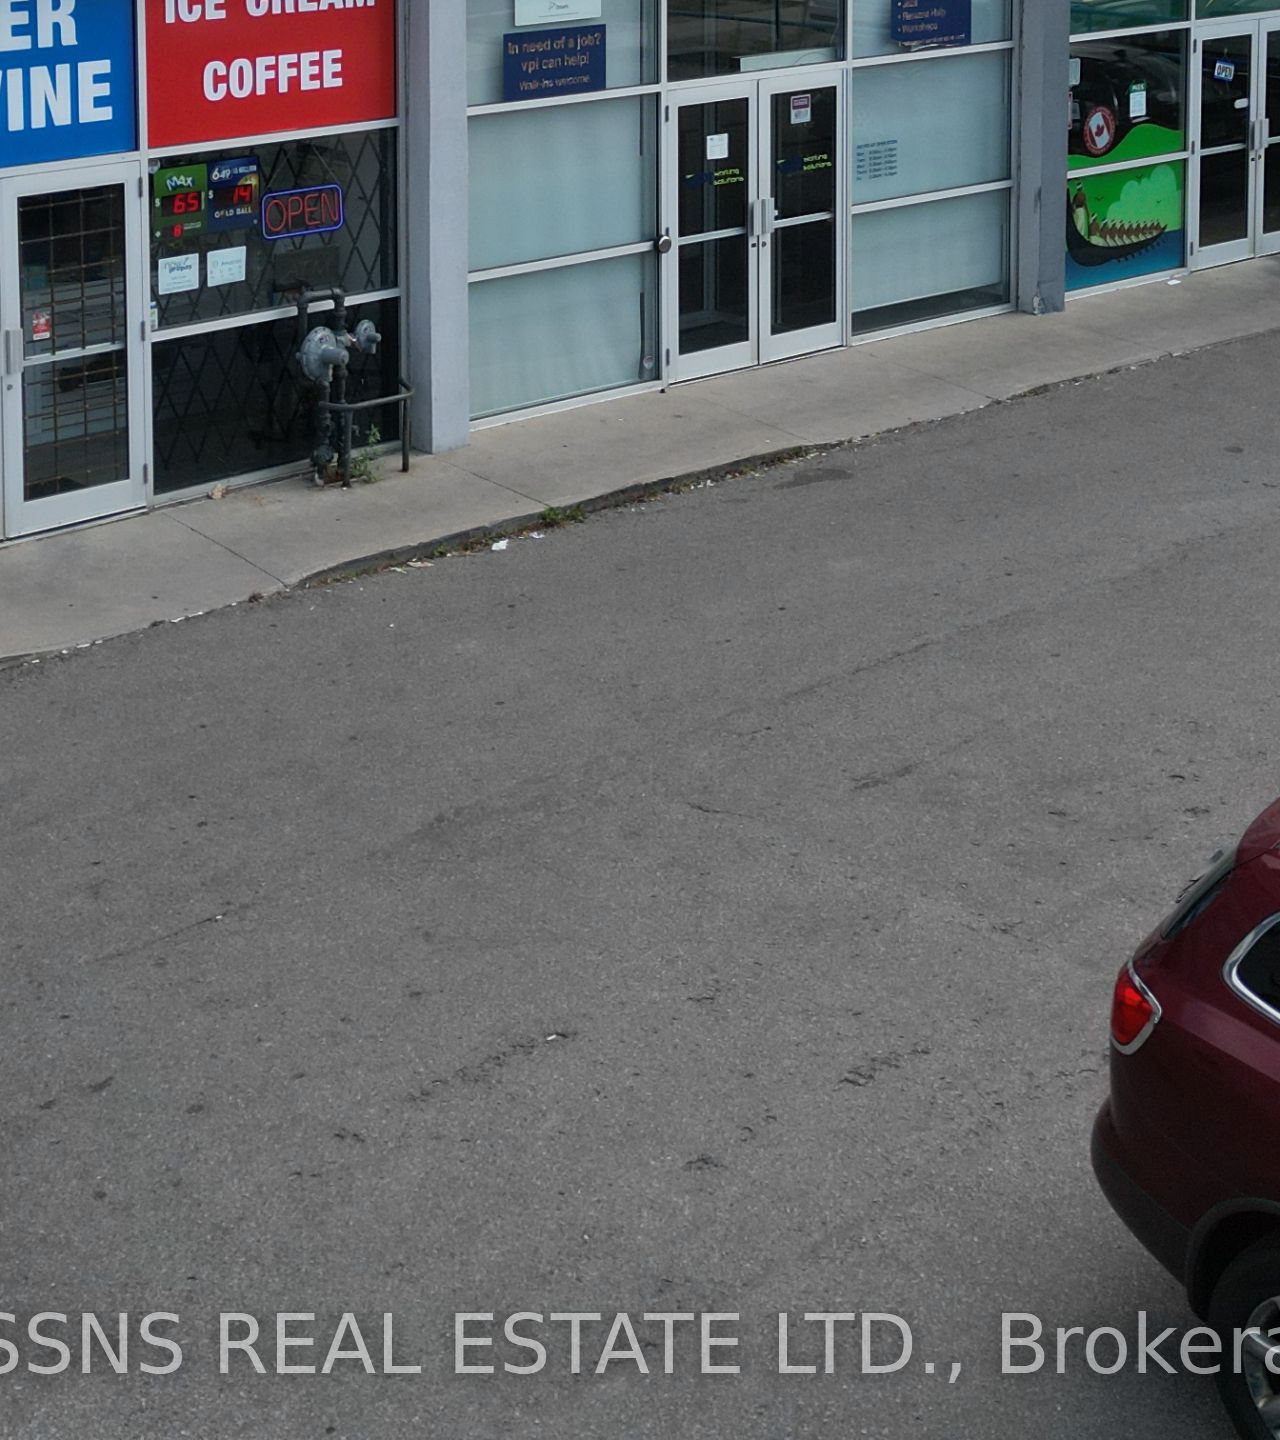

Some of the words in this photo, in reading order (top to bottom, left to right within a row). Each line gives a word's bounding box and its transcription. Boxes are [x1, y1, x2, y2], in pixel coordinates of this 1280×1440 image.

[508, 42, 519, 55] In
[522, 38, 551, 54] need
[553, 36, 565, 50] of
[577, 32, 602, 50] job?
[203, 48, 343, 102] COFFEE
[542, 57, 562, 70] can
[1217, 64, 1233, 78] OPEN
[173, 192, 199, 215] 65
[265, 192, 339, 232] OPEN
